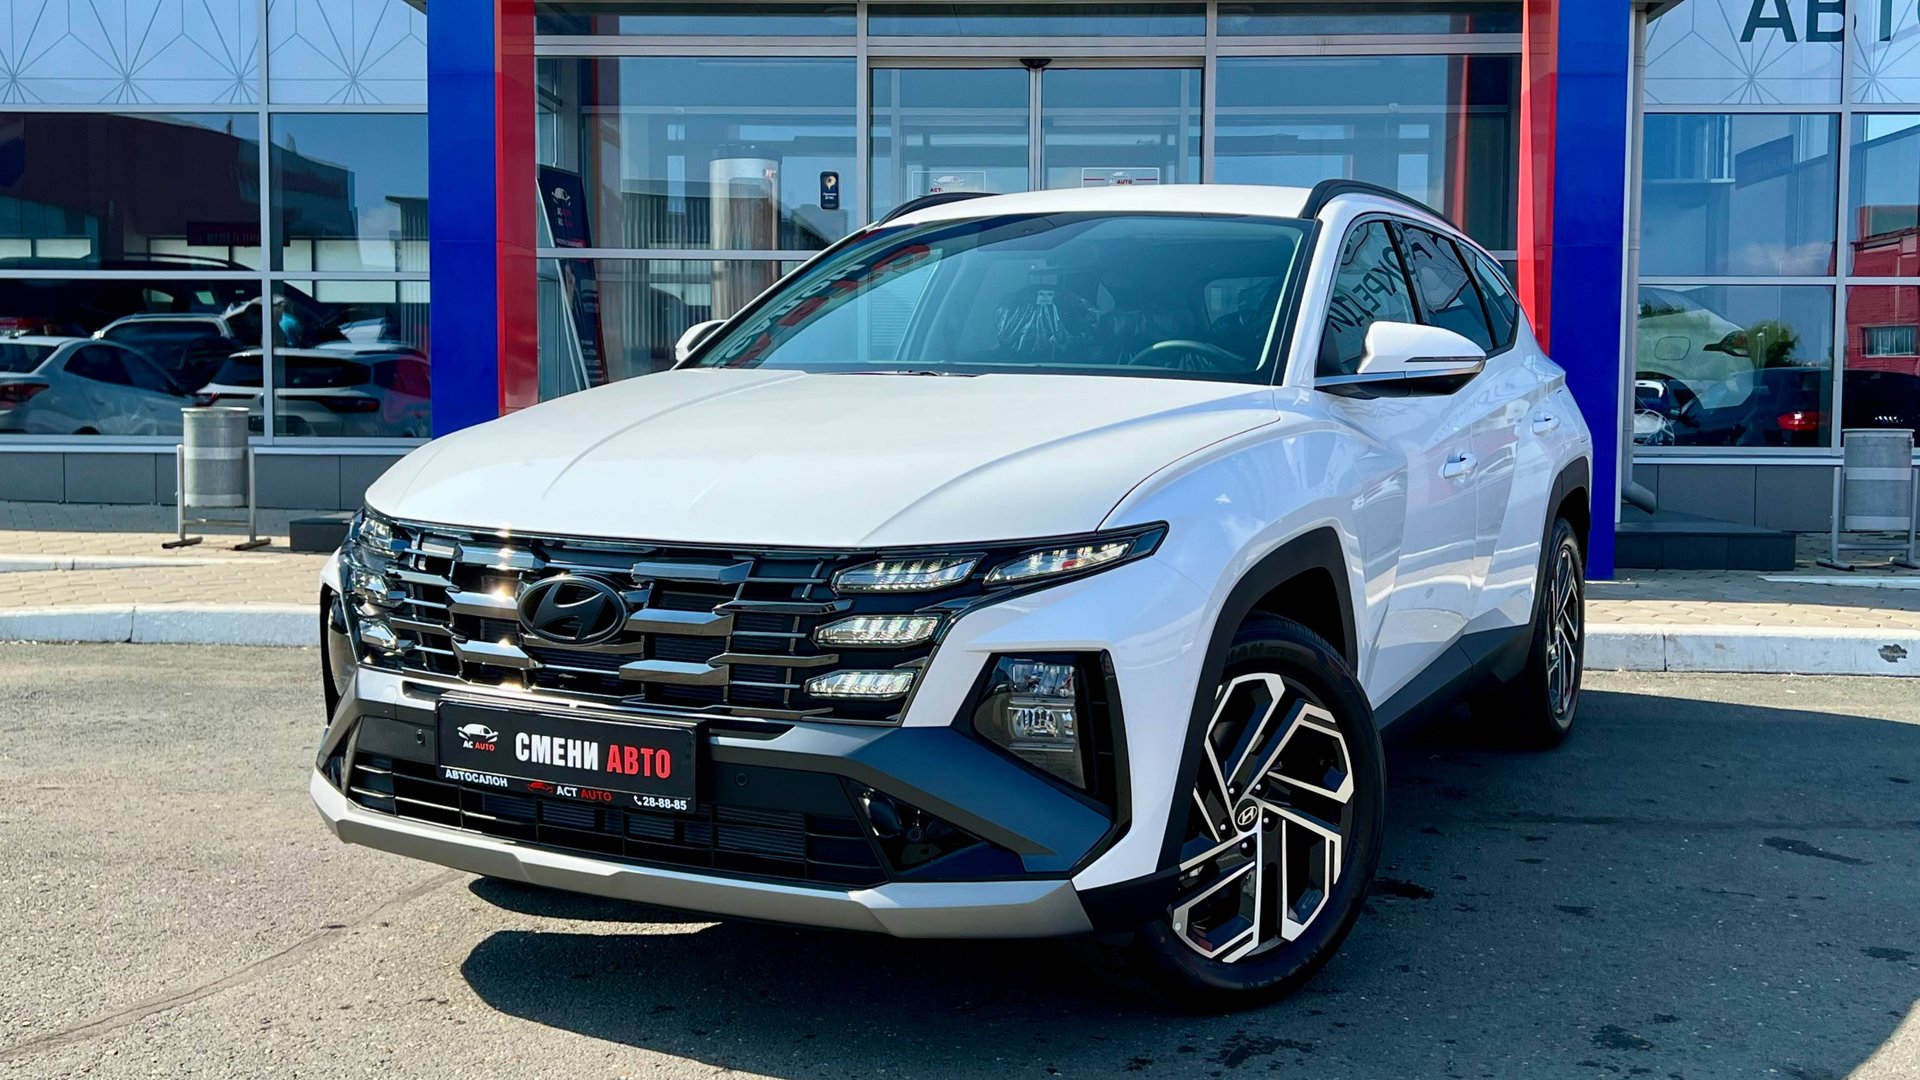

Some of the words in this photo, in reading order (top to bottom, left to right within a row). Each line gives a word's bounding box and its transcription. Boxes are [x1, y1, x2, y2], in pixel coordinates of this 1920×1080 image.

[475, 742, 495, 751] AUTO
[515, 732, 599, 771] СМЕНИ
[606, 744, 671, 779] АВТО
[445, 769, 508, 787] АВТОСАЛОН
[580, 788, 613, 802] AUTO
[642, 796, 687, 811] 28-88-85
